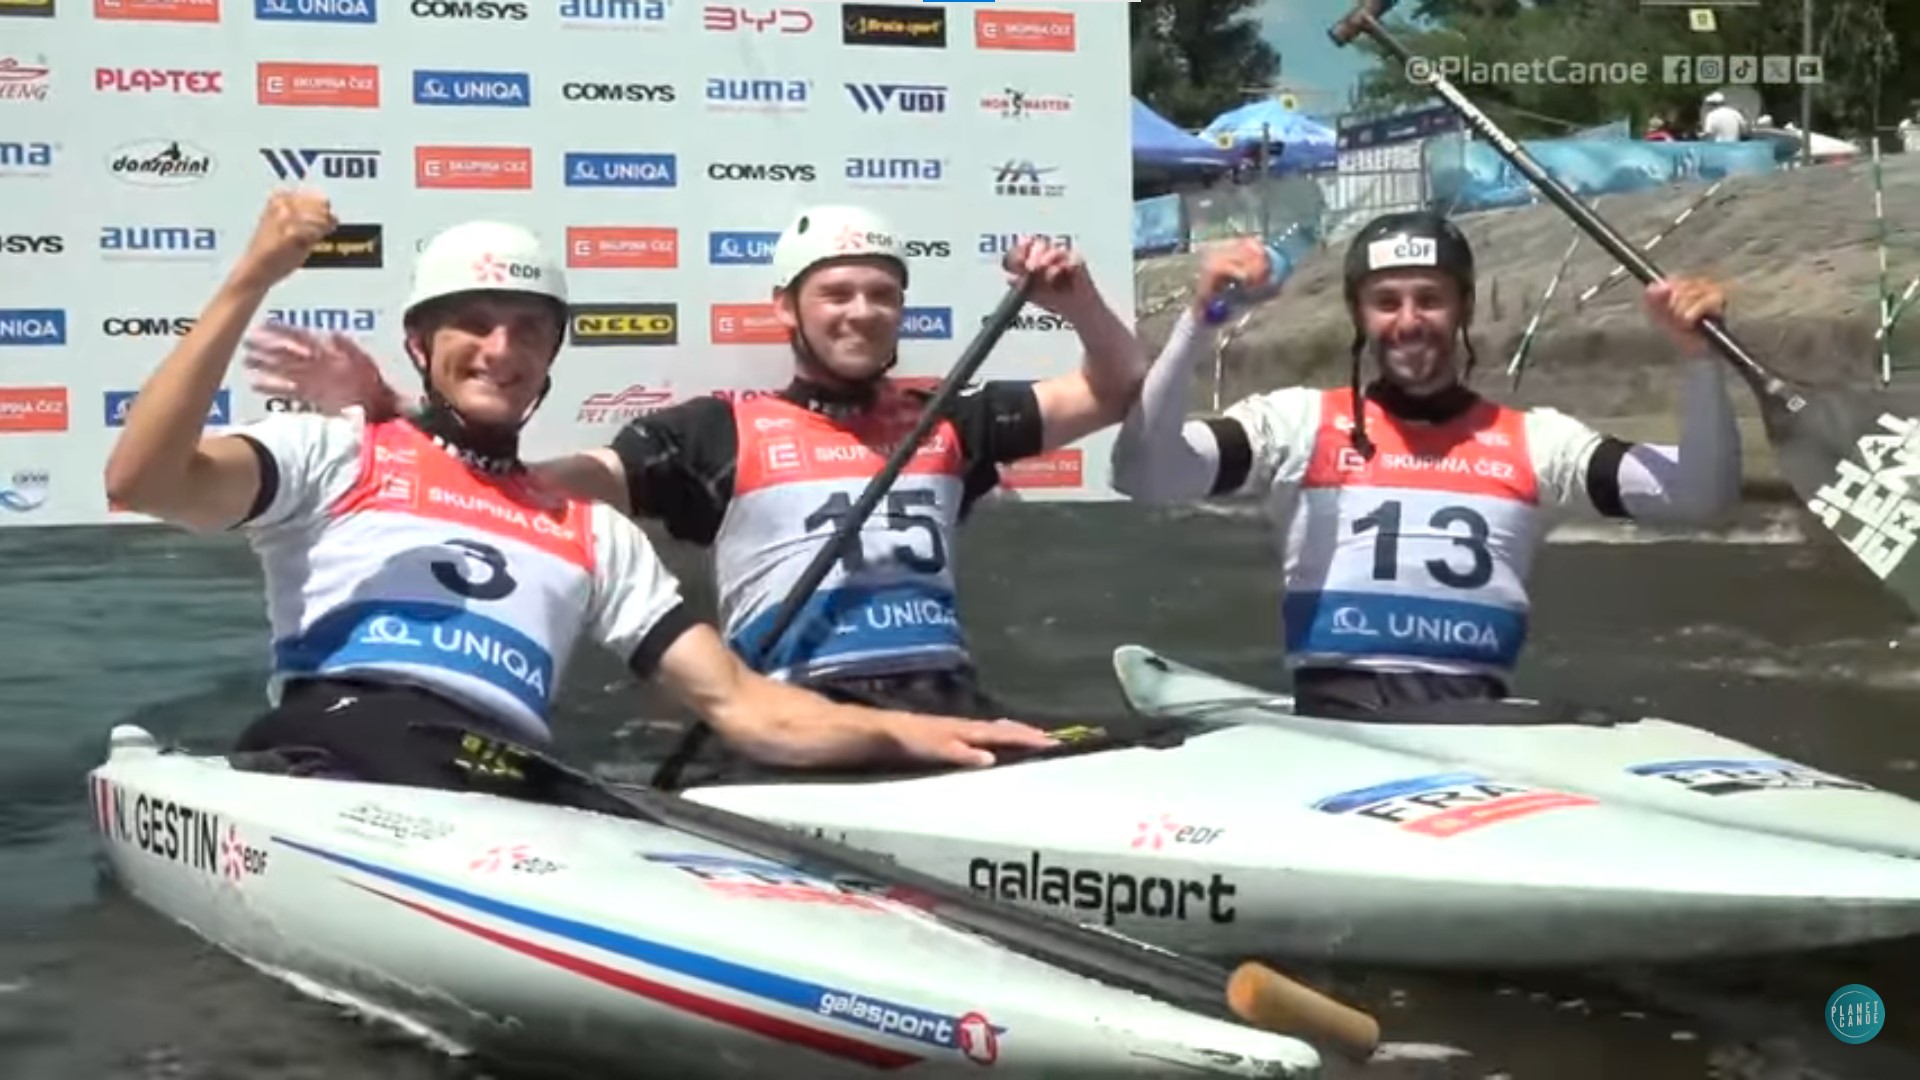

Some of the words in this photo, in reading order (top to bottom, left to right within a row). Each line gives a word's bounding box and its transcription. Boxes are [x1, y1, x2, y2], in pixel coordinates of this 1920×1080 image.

[300, 0, 369, 16] UNIQA
[560, 0, 665, 20] auma
[703, 7, 814, 33] BYD
[95, 67, 222, 93] PLASTEX
[453, 82, 522, 99] UNIQA
[706, 78, 807, 102] auma
[844, 83, 948, 114] WUDI
[259, 148, 381, 181] WUDI
[604, 163, 670, 181] UNIQA
[845, 157, 941, 180] auma
[100, 227, 216, 249] auma
[578, 316, 670, 332] NELO
[1380, 453, 1471, 474] SKUPINA
[1474, 456, 1515, 479] ČEZ
[428, 485, 529, 529] SKUPINA
[803, 488, 946, 574] 15
[1352, 500, 1494, 589] 13
[430, 538, 518, 601] 3
[1388, 612, 1499, 650] UNIQA
[433, 627, 546, 697] UNIQA
[1355, 784, 1529, 823] FRA
[135, 793, 218, 875] GESTIN
[968, 853, 1236, 926] galasport
[819, 993, 954, 1043] galasport
